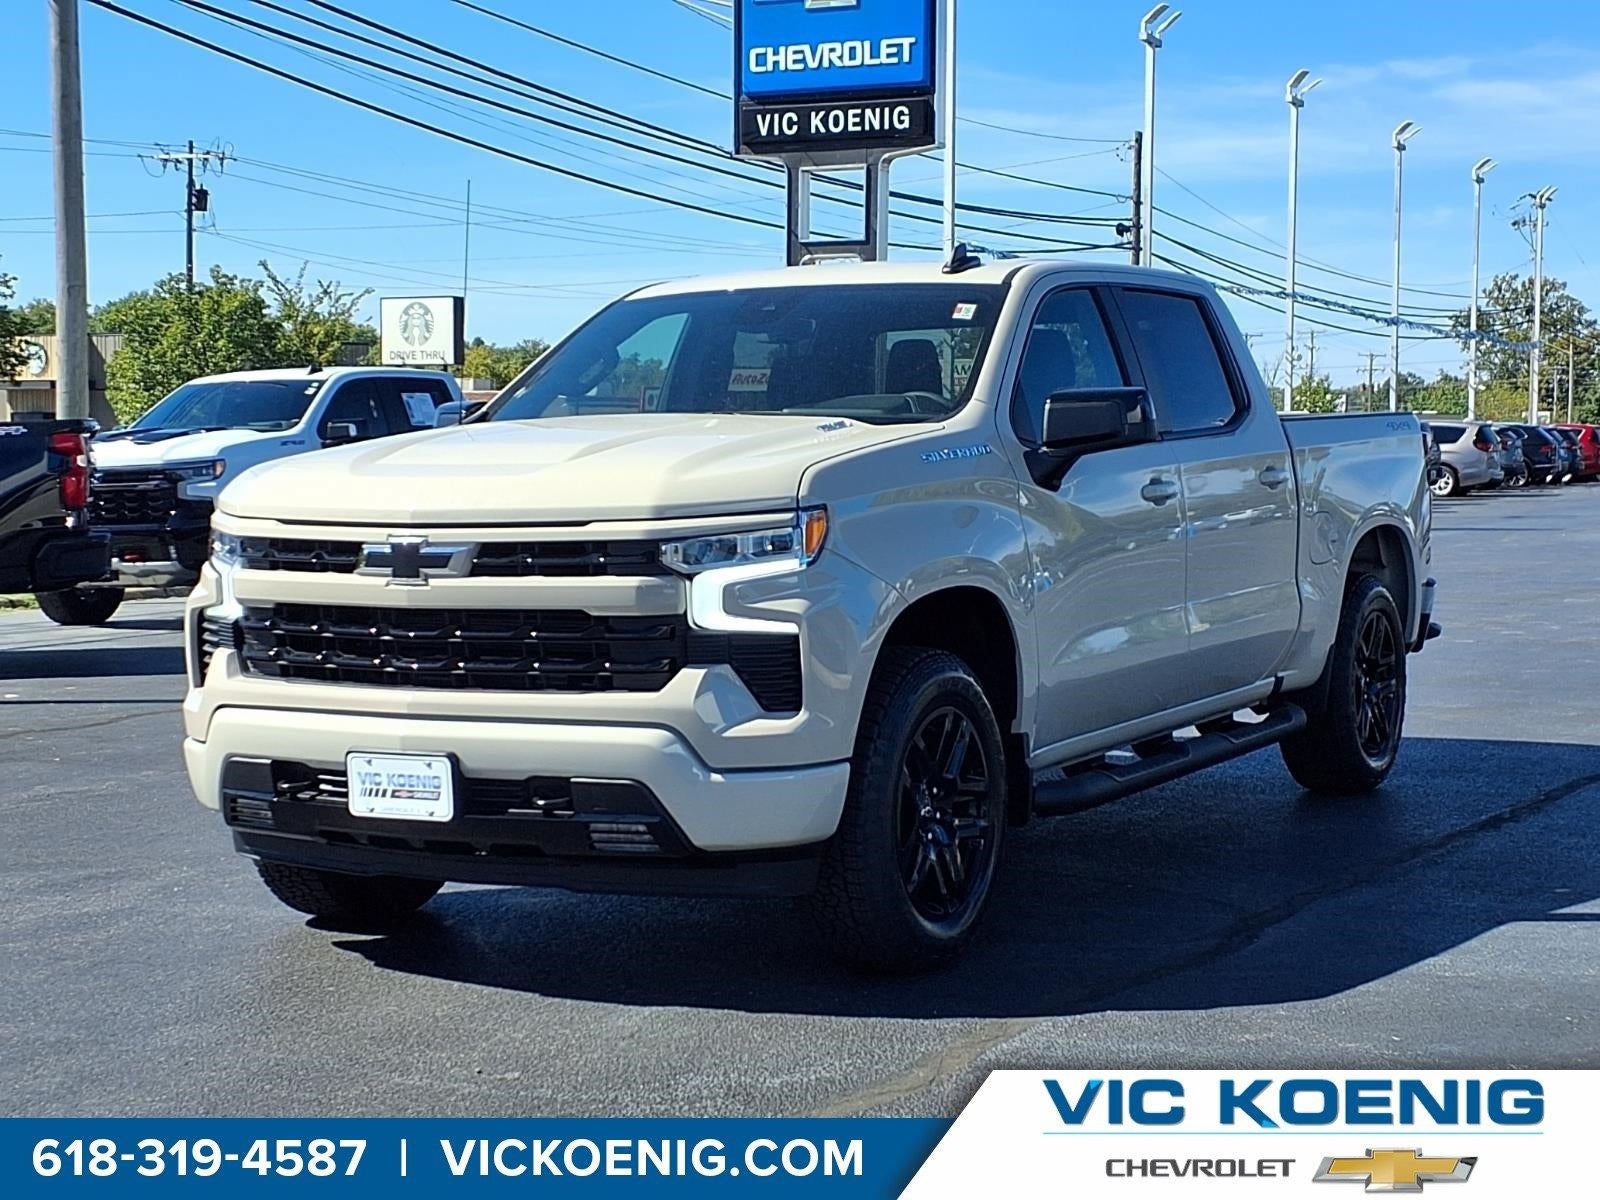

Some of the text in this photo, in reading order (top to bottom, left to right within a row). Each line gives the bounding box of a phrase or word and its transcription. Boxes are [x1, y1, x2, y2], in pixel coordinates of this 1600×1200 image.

[749, 37, 916, 73] CHEVROLET
[756, 103, 910, 136] VIC KOENIG
[389, 350, 446, 361] DRIVE THRU
[357, 771, 442, 790] VIC KOENIG
